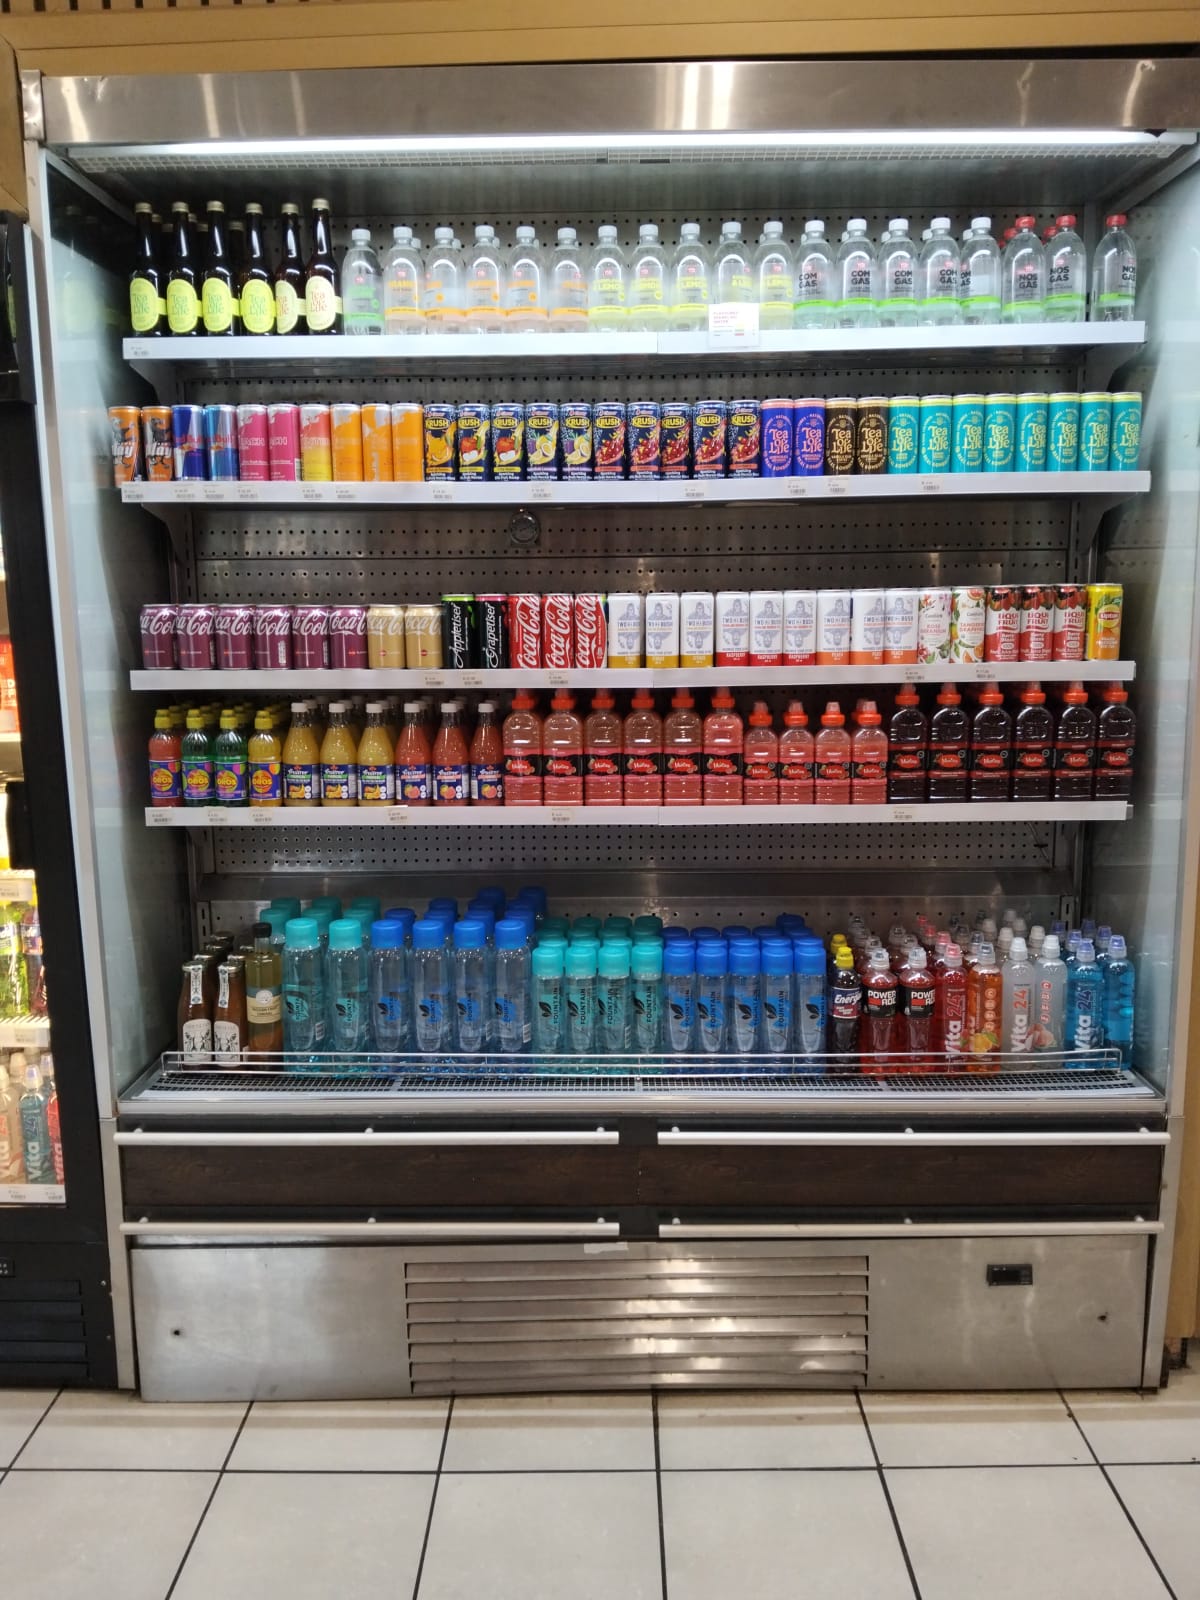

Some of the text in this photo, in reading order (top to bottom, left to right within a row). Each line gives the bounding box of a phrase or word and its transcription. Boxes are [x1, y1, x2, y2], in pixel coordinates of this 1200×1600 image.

[799, 272, 818, 281] COM
[1049, 274, 1069, 282] GAS
[426, 419, 449, 427] KRUSH
[528, 418, 552, 427] KRUSH
[566, 418, 590, 427] KRUSH
[632, 417, 656, 426] KRUSH
[662, 418, 685, 426] KRUSH
[697, 416, 720, 424] KRUSH
[732, 416, 756, 424] KRUSH
[892, 427, 912, 438] Tea
[928, 426, 948, 437] Tea
[963, 424, 982, 435] Tea
[988, 424, 1008, 435] Tea
[1028, 423, 1046, 434] Tea
[1058, 422, 1077, 433] Tea
[1089, 422, 1108, 432] Tea
[1121, 422, 1139, 432] Tea
[769, 429, 788, 440] Tea
[802, 428, 822, 438] Tea
[831, 428, 851, 439] Tea
[861, 428, 882, 439] Tea
[769, 442, 790, 454] Life
[802, 441, 823, 453] Life
[831, 441, 853, 454] Life
[861, 441, 883, 453] Life
[892, 440, 913, 452] Life
[928, 440, 949, 451] Life
[988, 437, 1010, 448] Life
[449, 602, 465, 668] Appletiser
[482, 602, 499, 668] Grapetiser
[868, 990, 896, 999] POWER
[911, 989, 935, 999] POWE
[1013, 989, 1028, 1009] 24
[947, 994, 962, 1016] 24
[1078, 990, 1092, 1010] 24
